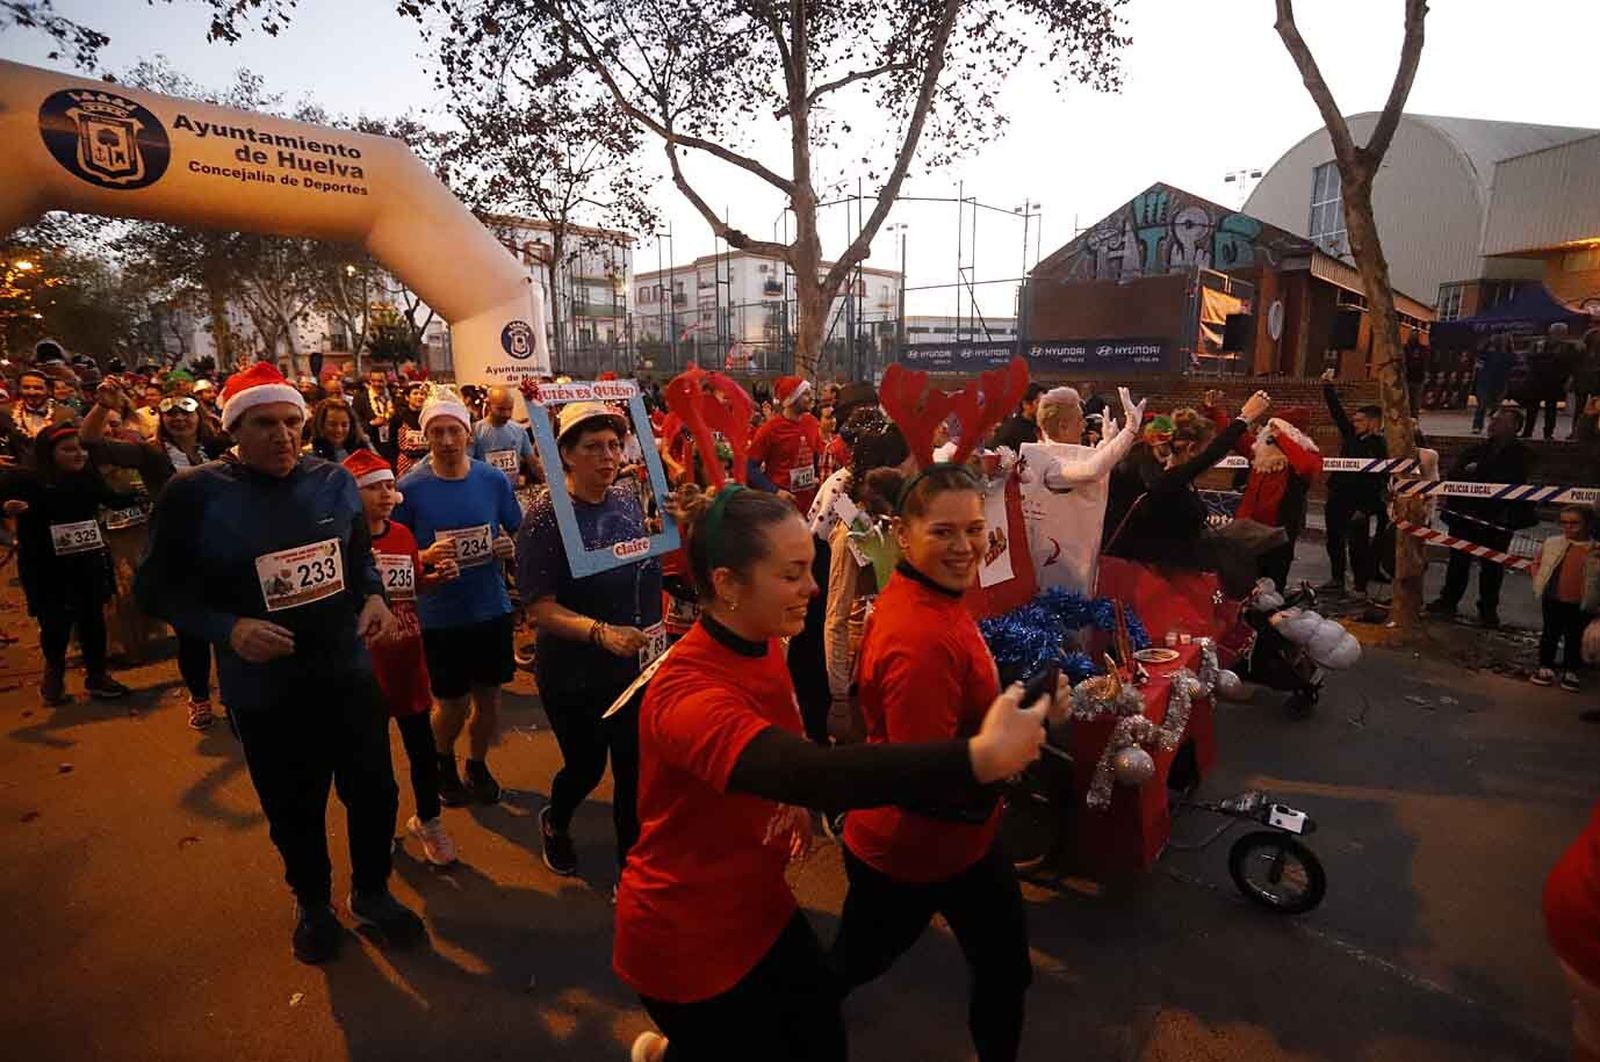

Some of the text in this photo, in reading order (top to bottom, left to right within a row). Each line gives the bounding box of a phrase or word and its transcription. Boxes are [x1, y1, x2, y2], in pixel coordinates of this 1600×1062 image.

[173, 114, 362, 160] Ayuntamiento
[235, 144, 364, 179] de Huelva
[280, 173, 299, 187] de
[303, 177, 369, 197] Deportes
[974, 348, 1010, 357] HYUNDAI
[1045, 346, 1086, 356] HYUNDAI
[1114, 345, 1160, 355] HYUNDAI
[576, 388, 592, 399] ES
[1342, 461, 1360, 469] LOCAL
[1443, 483, 1492, 494] POLICIA LOCAL
[461, 539, 488, 556] 234
[615, 540, 649, 556] Claire
[298, 558, 336, 587] 233
[387, 569, 412, 588] 235
